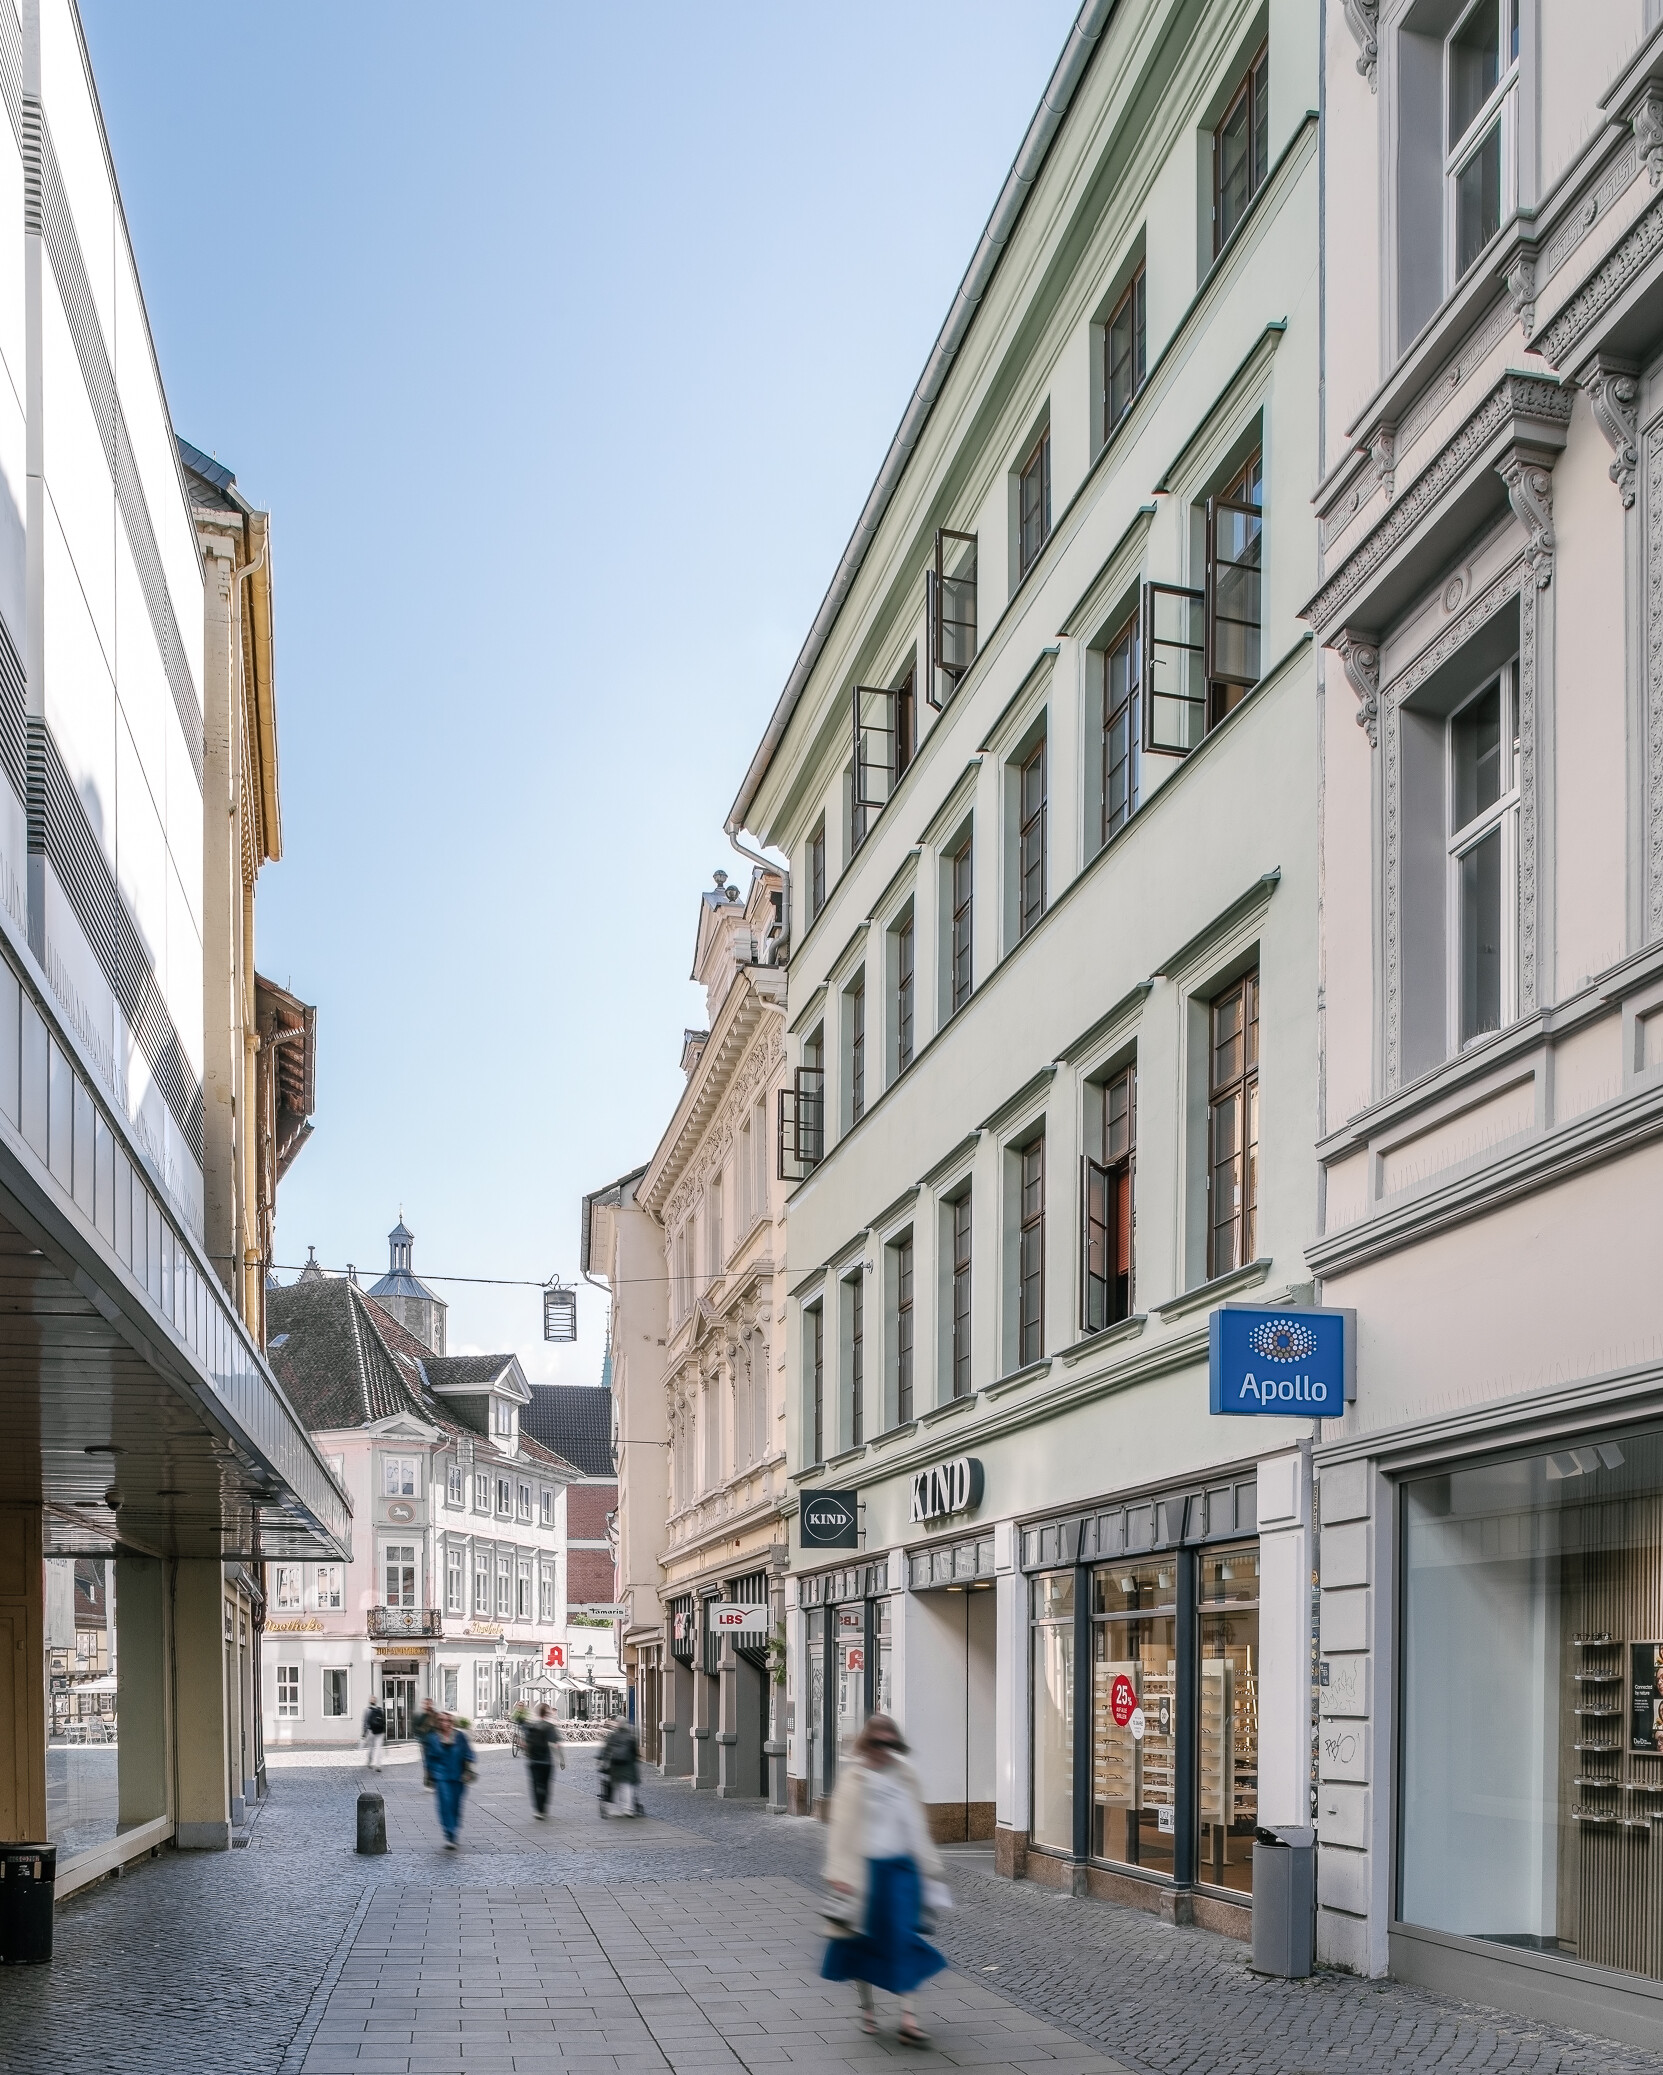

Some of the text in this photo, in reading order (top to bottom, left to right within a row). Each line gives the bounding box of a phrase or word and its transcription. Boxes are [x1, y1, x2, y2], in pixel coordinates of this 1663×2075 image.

[1239, 1373, 1327, 1405] Apollo
[908, 1457, 972, 1524] KIND
[809, 1513, 847, 1525] KIND
[264, 1618, 324, 1632] Apotheke
[719, 1615, 743, 1625] LBS
